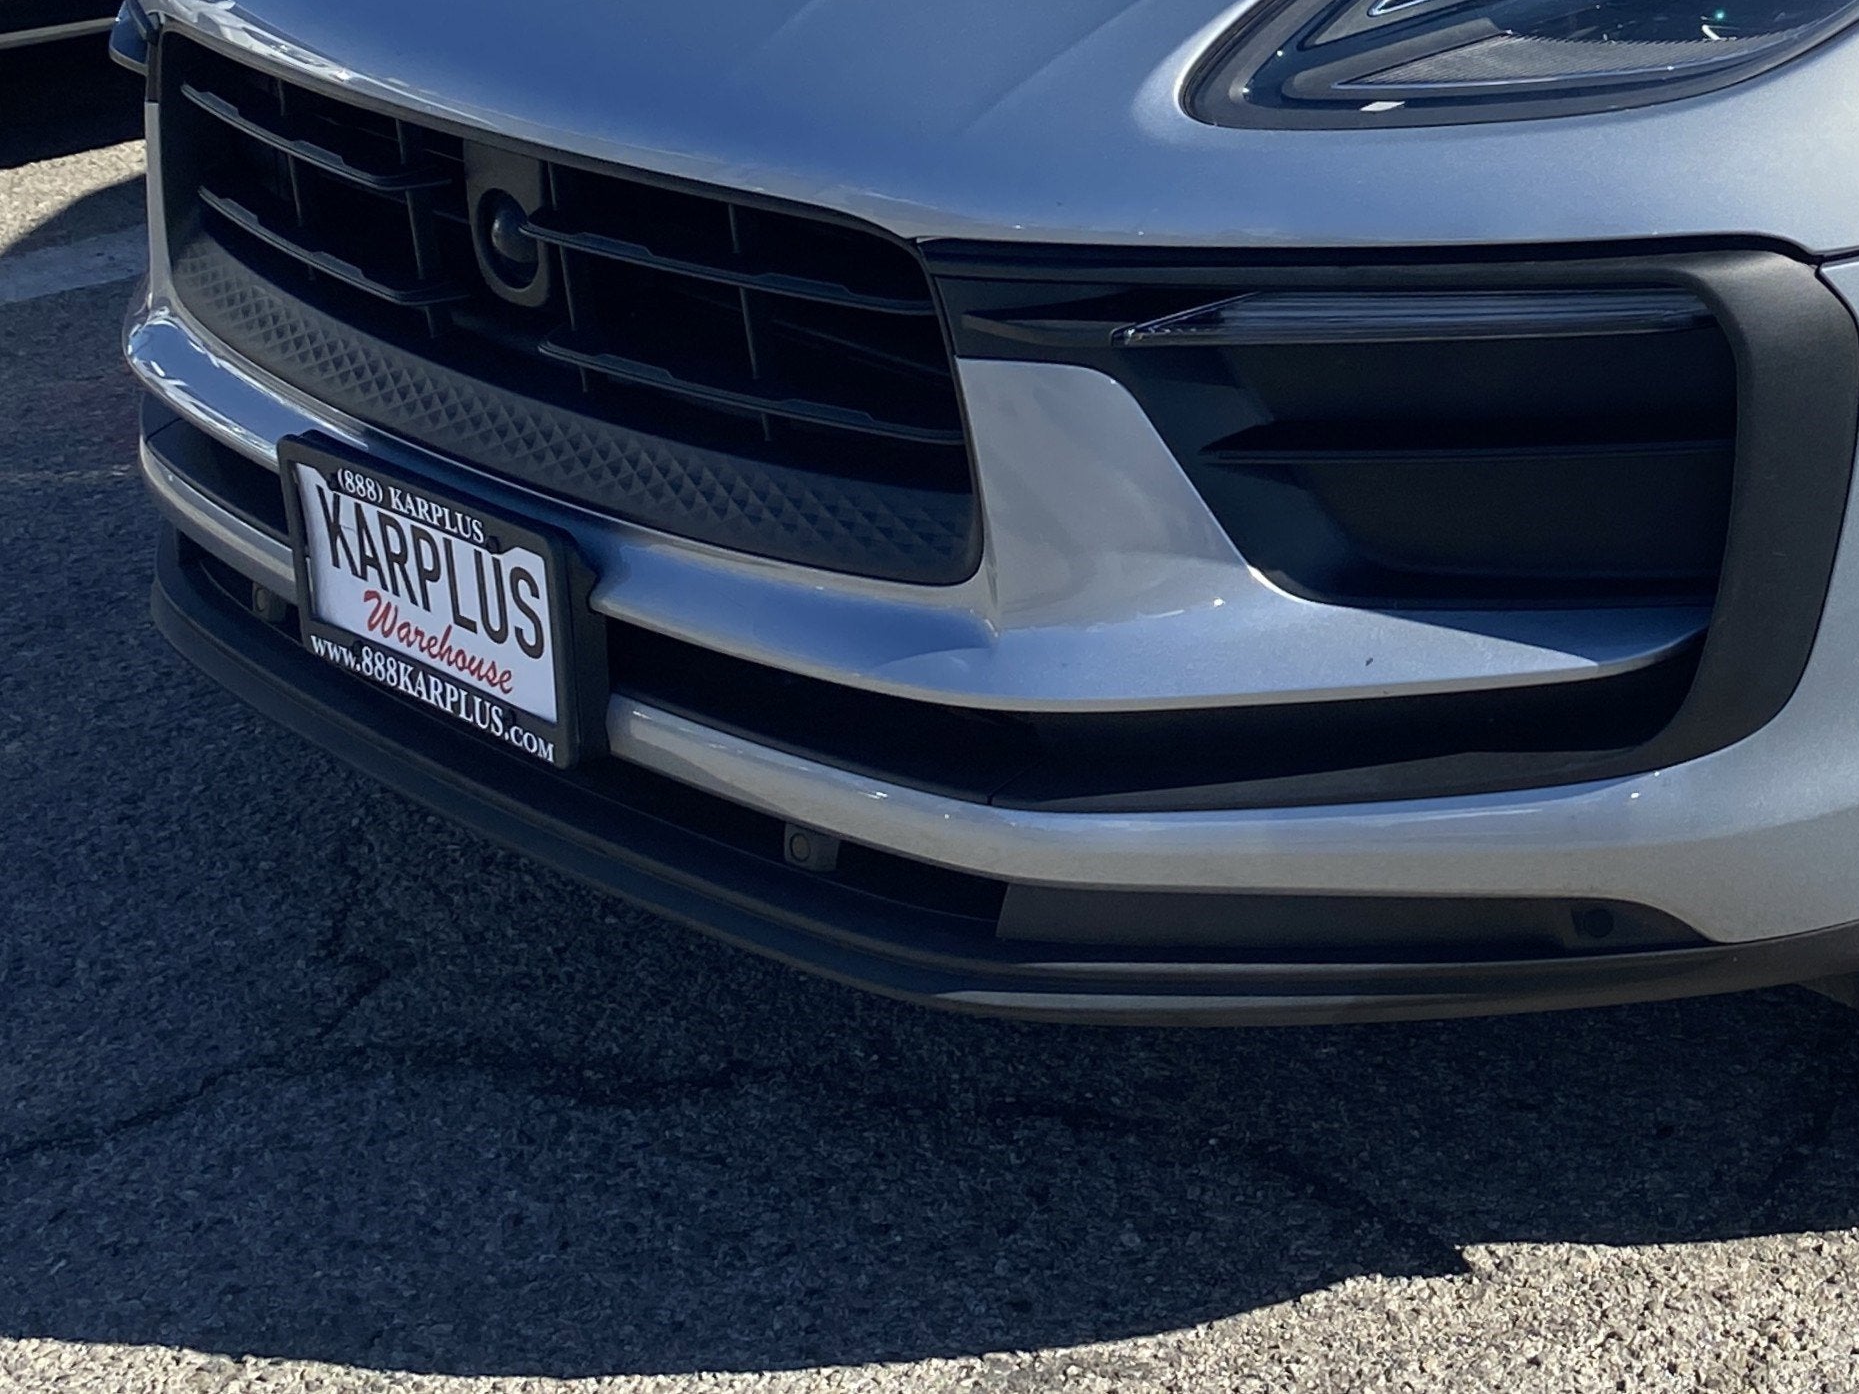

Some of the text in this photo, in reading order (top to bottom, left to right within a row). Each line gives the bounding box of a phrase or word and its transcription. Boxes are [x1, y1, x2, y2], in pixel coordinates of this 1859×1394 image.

[336, 467, 485, 545] (888) KARPLUS
[317, 484, 545, 660] KARPLUS
[363, 589, 513, 695] Warehouse
